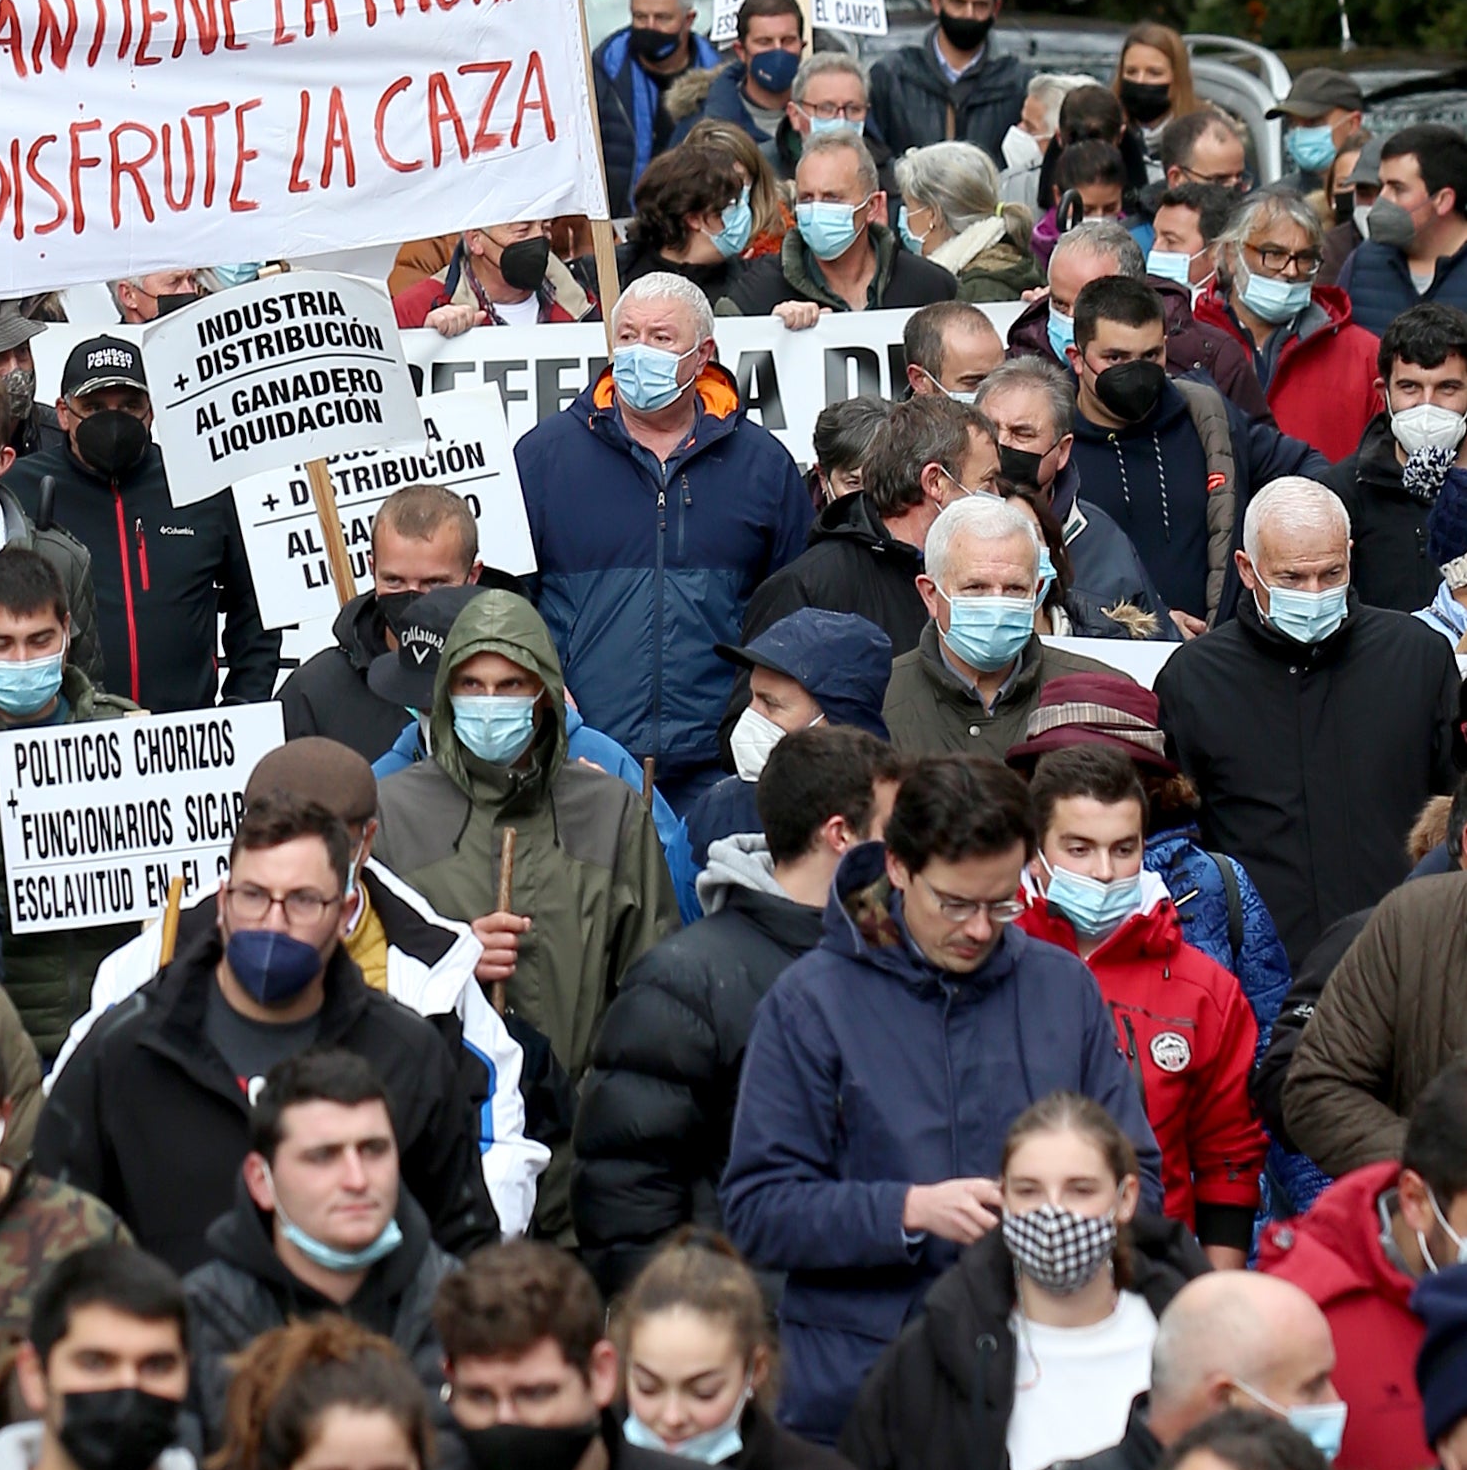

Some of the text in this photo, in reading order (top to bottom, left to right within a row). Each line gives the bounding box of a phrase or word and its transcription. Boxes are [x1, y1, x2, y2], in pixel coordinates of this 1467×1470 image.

[835, 1, 881, 29] CAMPO
[288, 86, 356, 193] LA
[374, 50, 557, 173] CAZA
[196, 290, 347, 348] INDUSTRIA
[173, 316, 385, 393] + DISTRIBUCIÓN
[194, 367, 384, 436] AL GANADERO
[207, 390, 384, 463] LIQUIDACIÓN
[262, 494, 280, 512] +
[287, 528, 322, 559] AL
[14, 718, 235, 788] POLITICOS CHORIZOS
[7, 789, 19, 819] +
[21, 798, 174, 861] FUNCIONARIOS
[13, 867, 135, 923] ESCLAVITUD
[145, 862, 169, 909] EN
